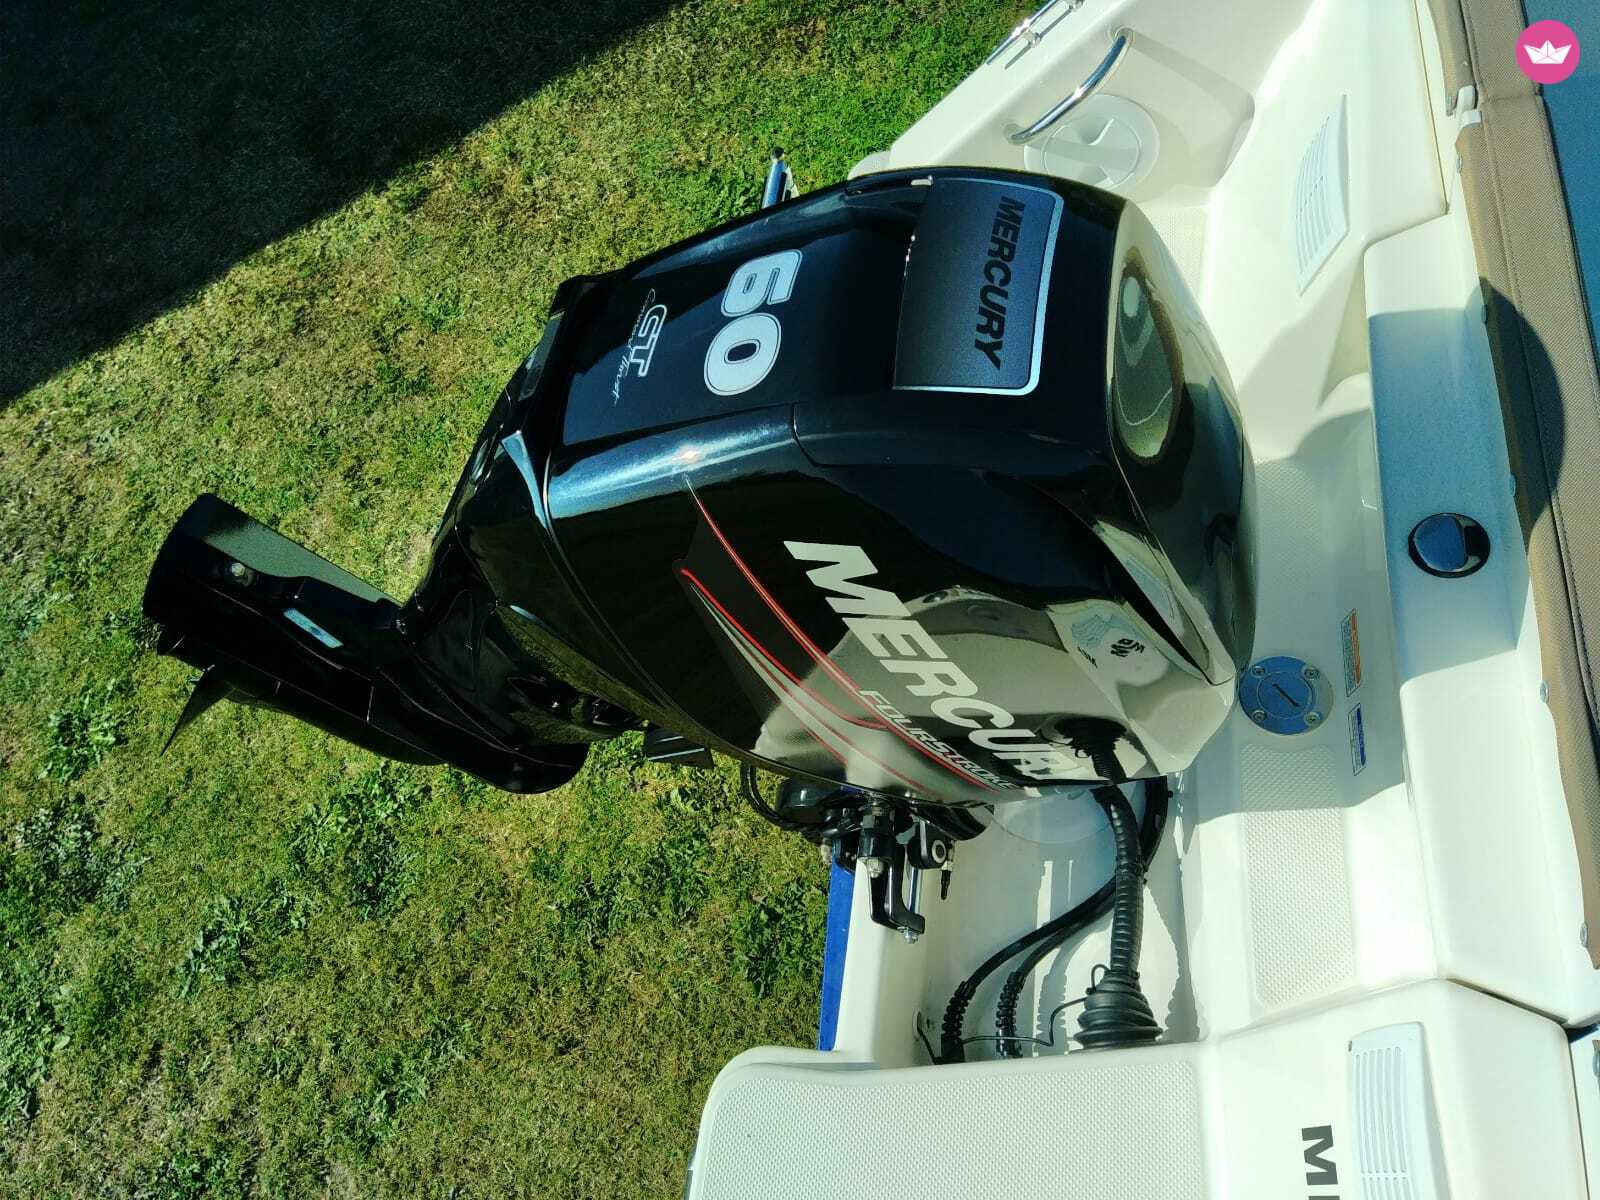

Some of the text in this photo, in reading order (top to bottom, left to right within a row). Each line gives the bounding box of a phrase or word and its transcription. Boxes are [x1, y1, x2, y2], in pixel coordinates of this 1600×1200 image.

[704, 249, 803, 396] 60
[973, 195, 1025, 371] MERCURY
[783, 540, 1080, 798] MERCUR
[1301, 1125, 1341, 1200] M
